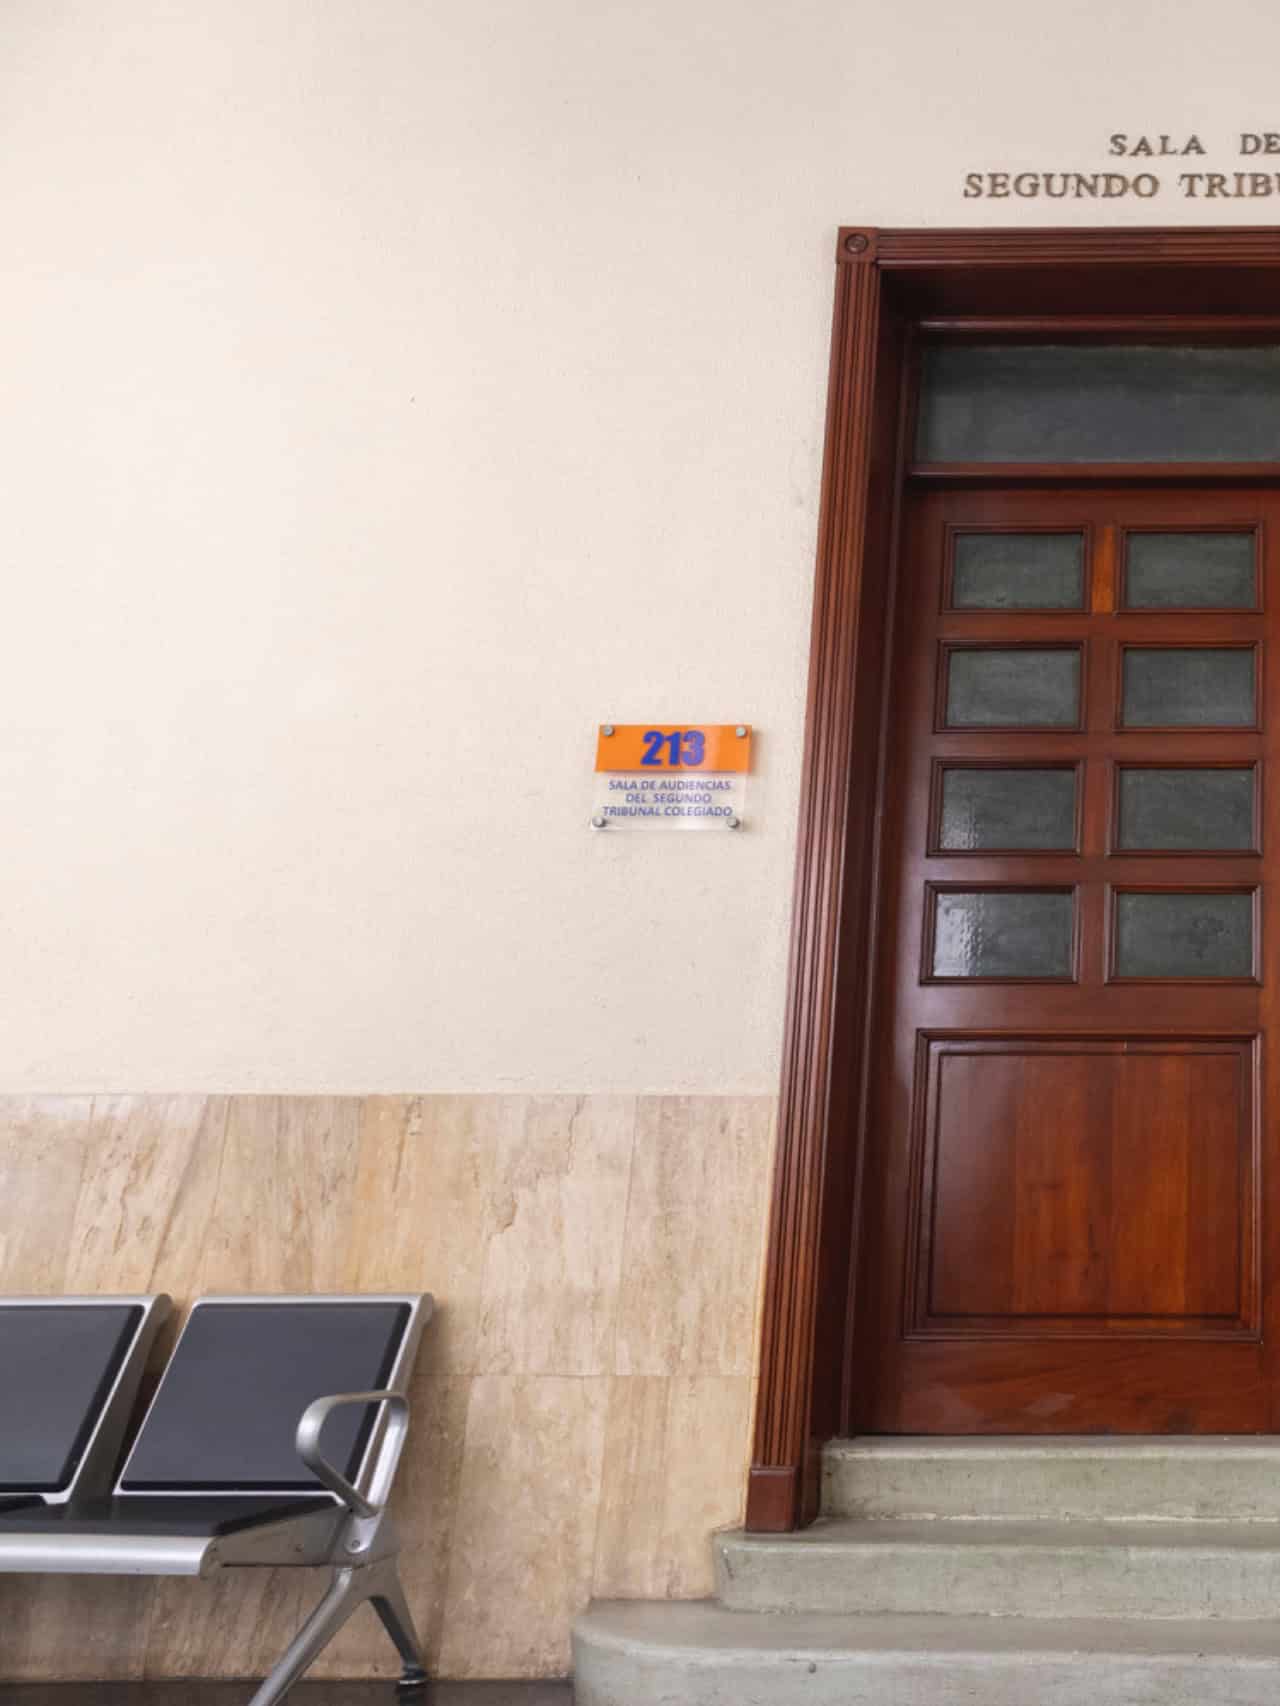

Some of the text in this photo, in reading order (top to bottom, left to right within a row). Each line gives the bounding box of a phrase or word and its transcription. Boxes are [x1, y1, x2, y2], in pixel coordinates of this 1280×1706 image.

[1108, 133, 1206, 156] SALA
[963, 171, 1160, 198] SEGUNDO
[640, 730, 705, 766] 213
[609, 780, 732, 791] SALA DE AUDIENCIAS
[626, 793, 713, 804] DEL SEGUNDO
[603, 806, 734, 817] TRIBUNAL COLEGIADO
